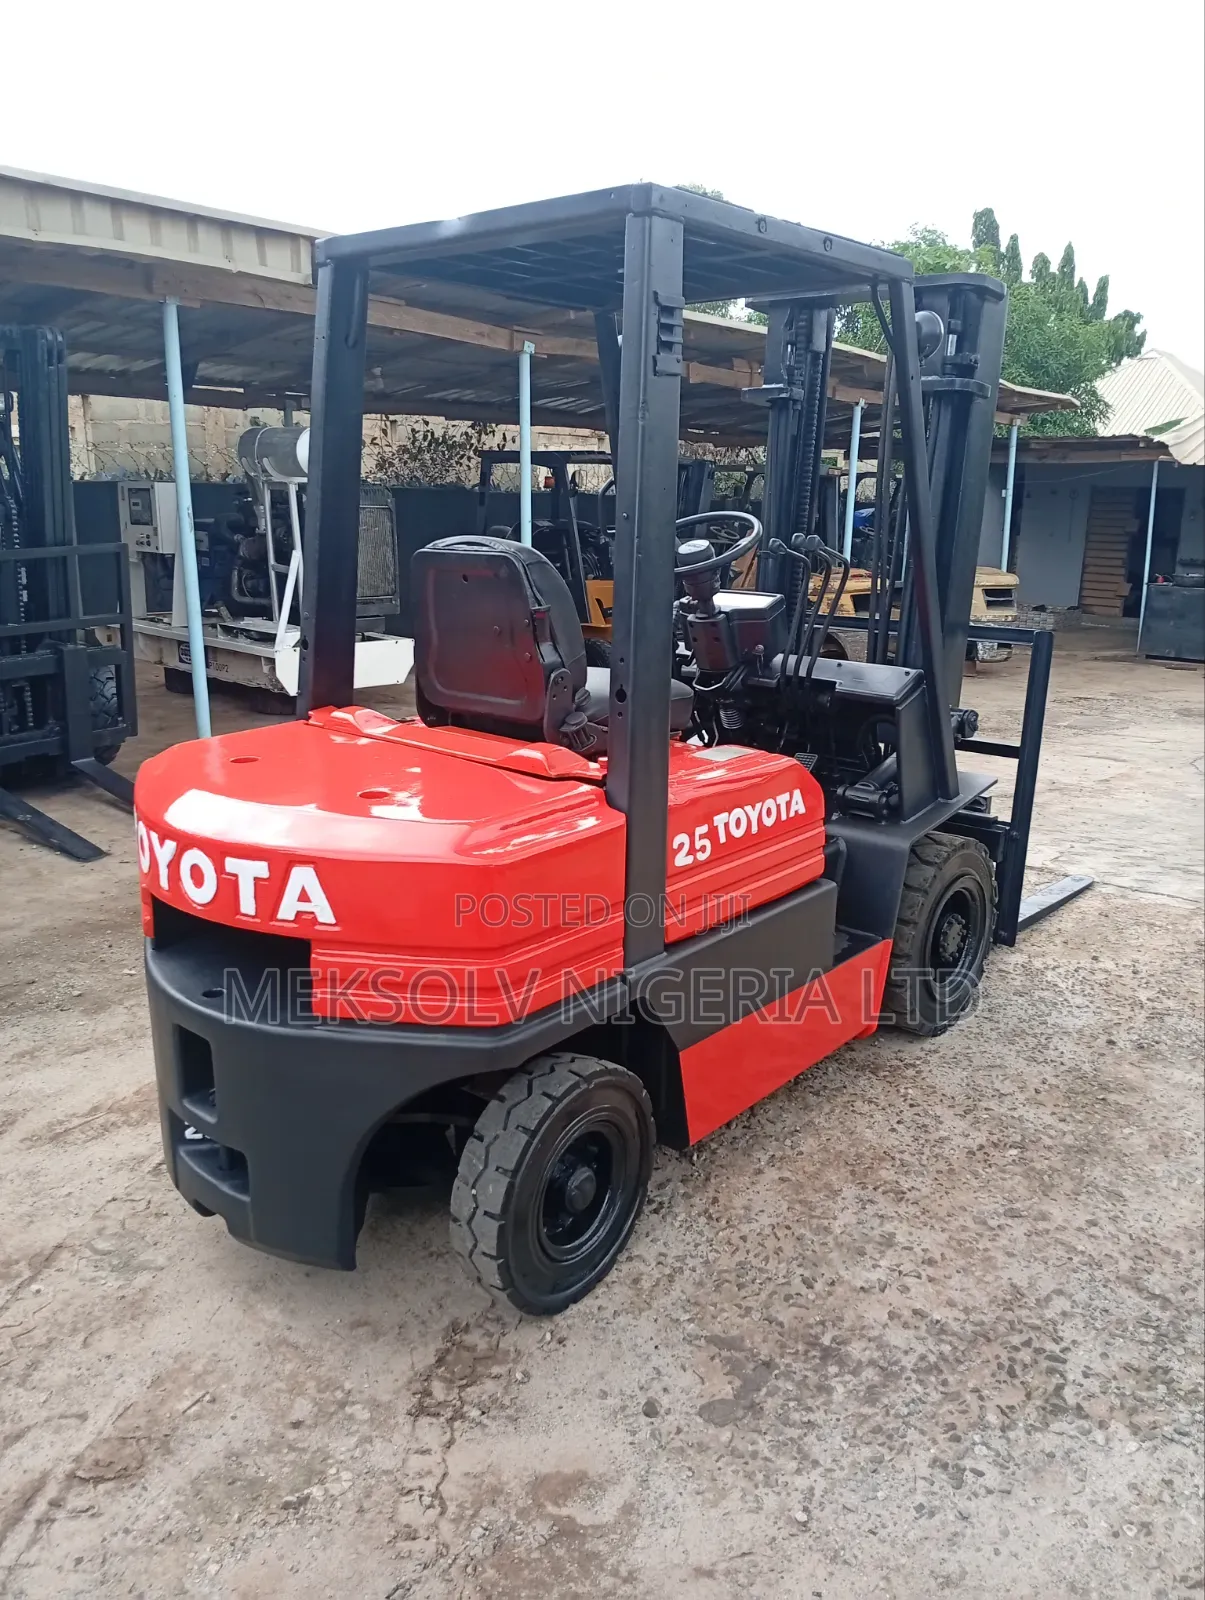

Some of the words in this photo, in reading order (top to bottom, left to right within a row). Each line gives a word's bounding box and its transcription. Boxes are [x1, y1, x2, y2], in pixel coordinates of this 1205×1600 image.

[133, 804, 337, 925] OYOTA
[672, 824, 712, 867] 25
[713, 788, 806, 844] TOYOTA
